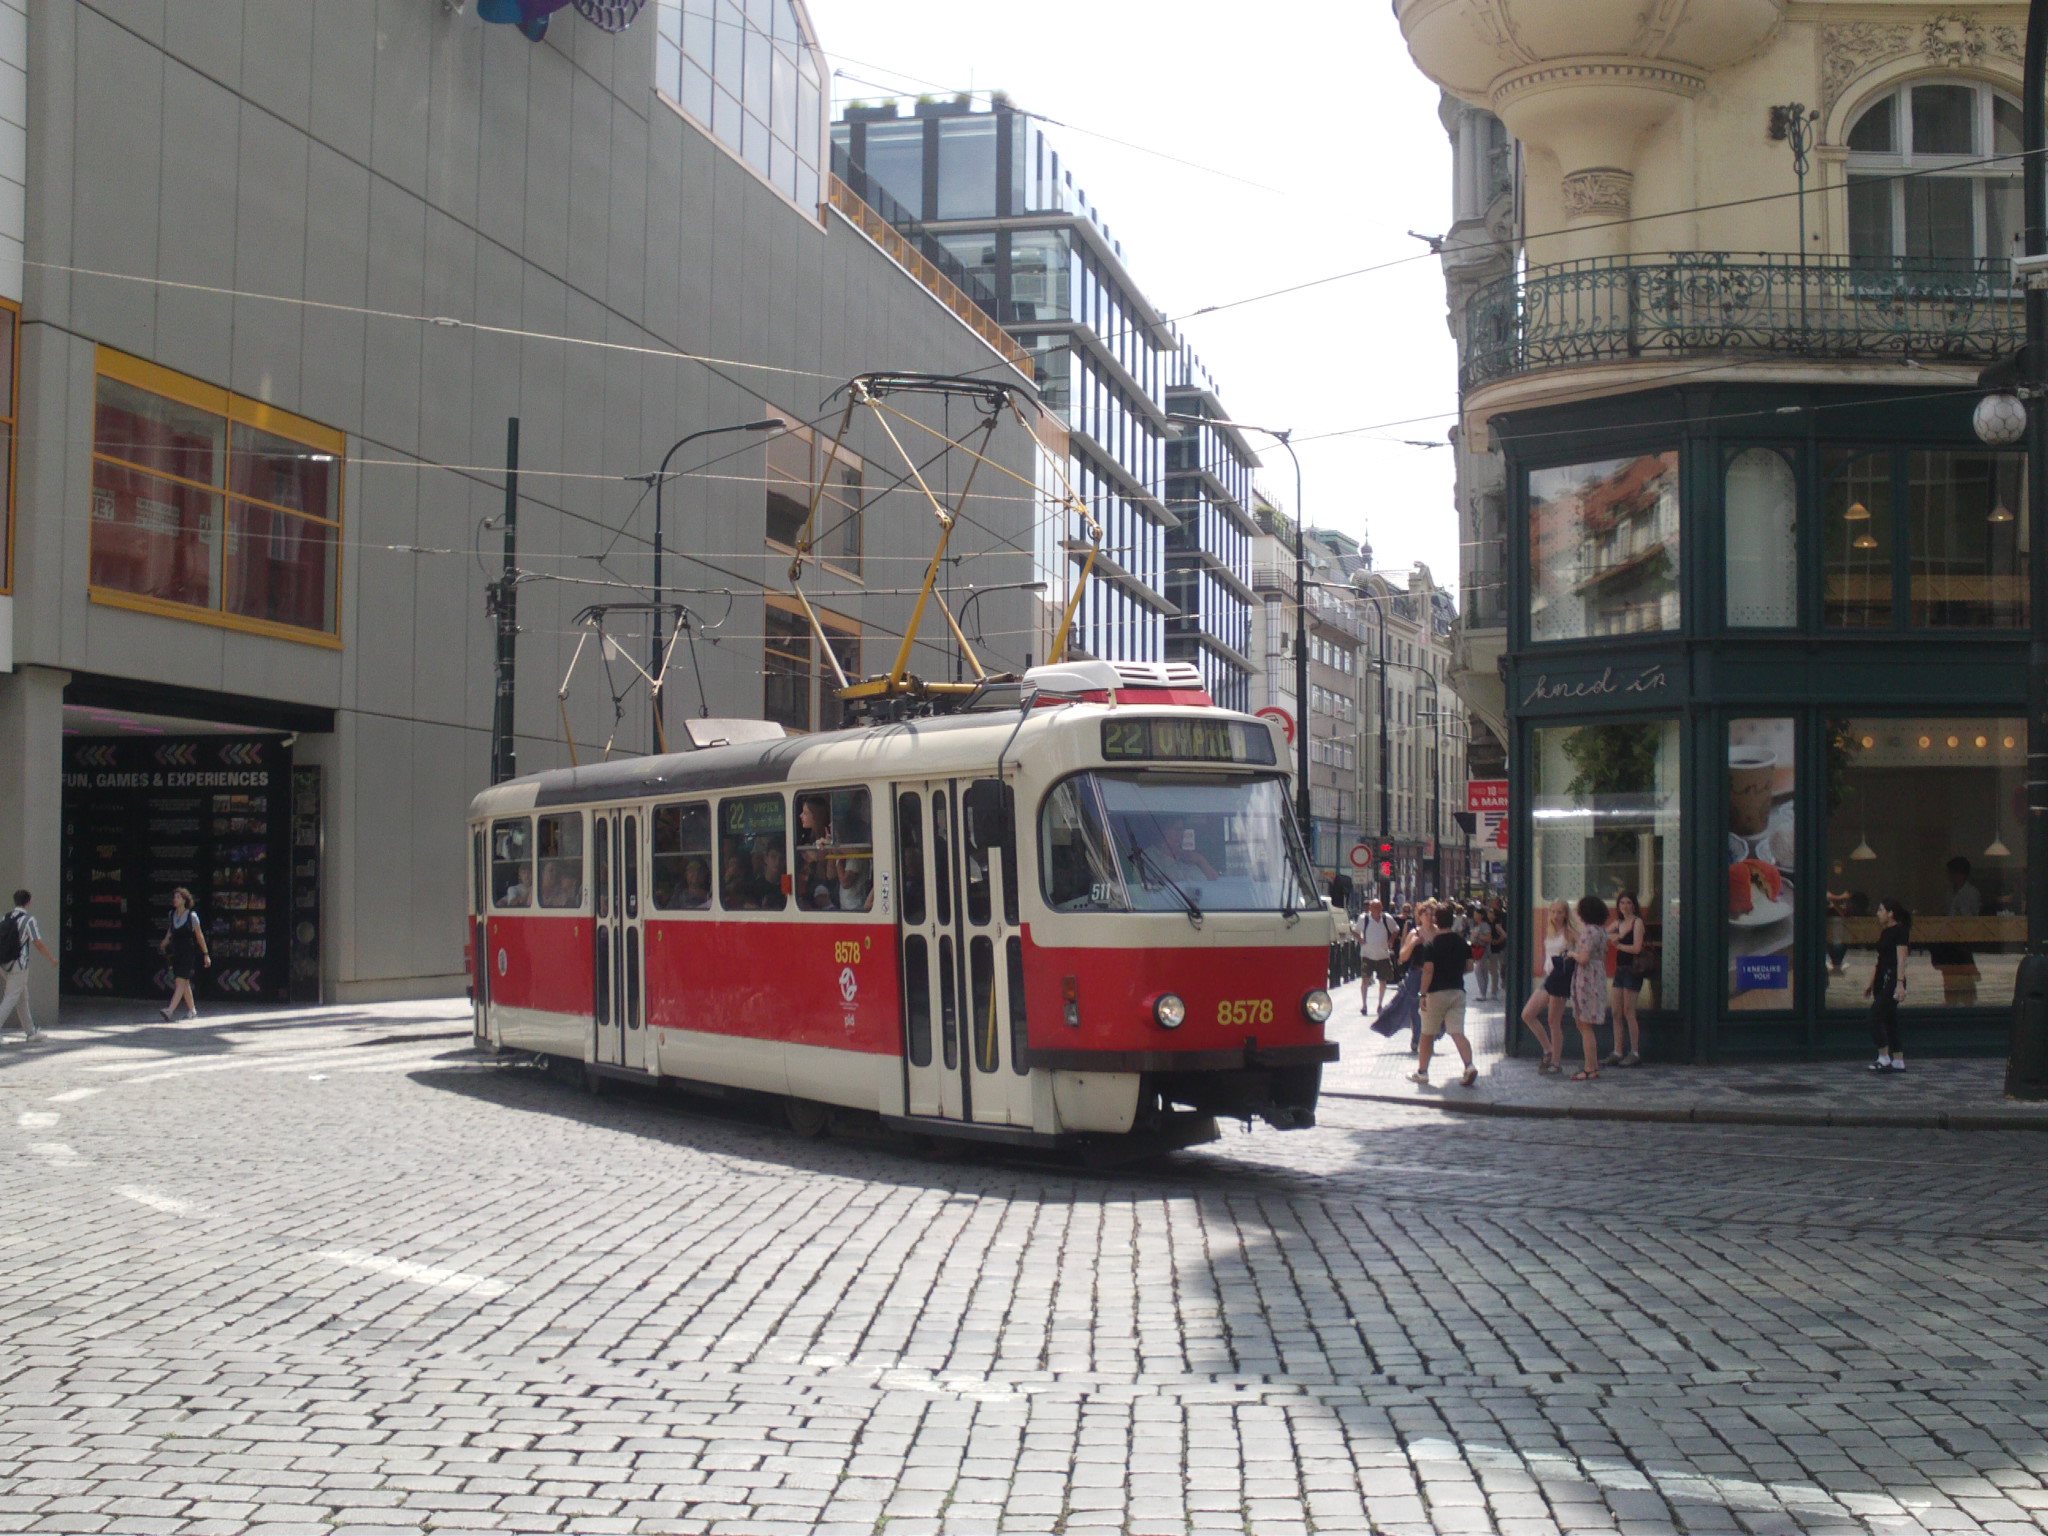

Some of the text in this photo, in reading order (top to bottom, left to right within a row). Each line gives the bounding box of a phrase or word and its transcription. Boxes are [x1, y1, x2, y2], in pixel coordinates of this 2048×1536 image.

[1105, 721, 1143, 754] 22
[96, 773, 149, 788] GAMES
[153, 773, 163, 787] &
[167, 771, 269, 787] EXPERIENCES
[730, 802, 745, 829] 22
[1091, 883, 1110, 900] 511
[835, 941, 861, 964] 8578
[1217, 999, 1274, 1026] 8578
